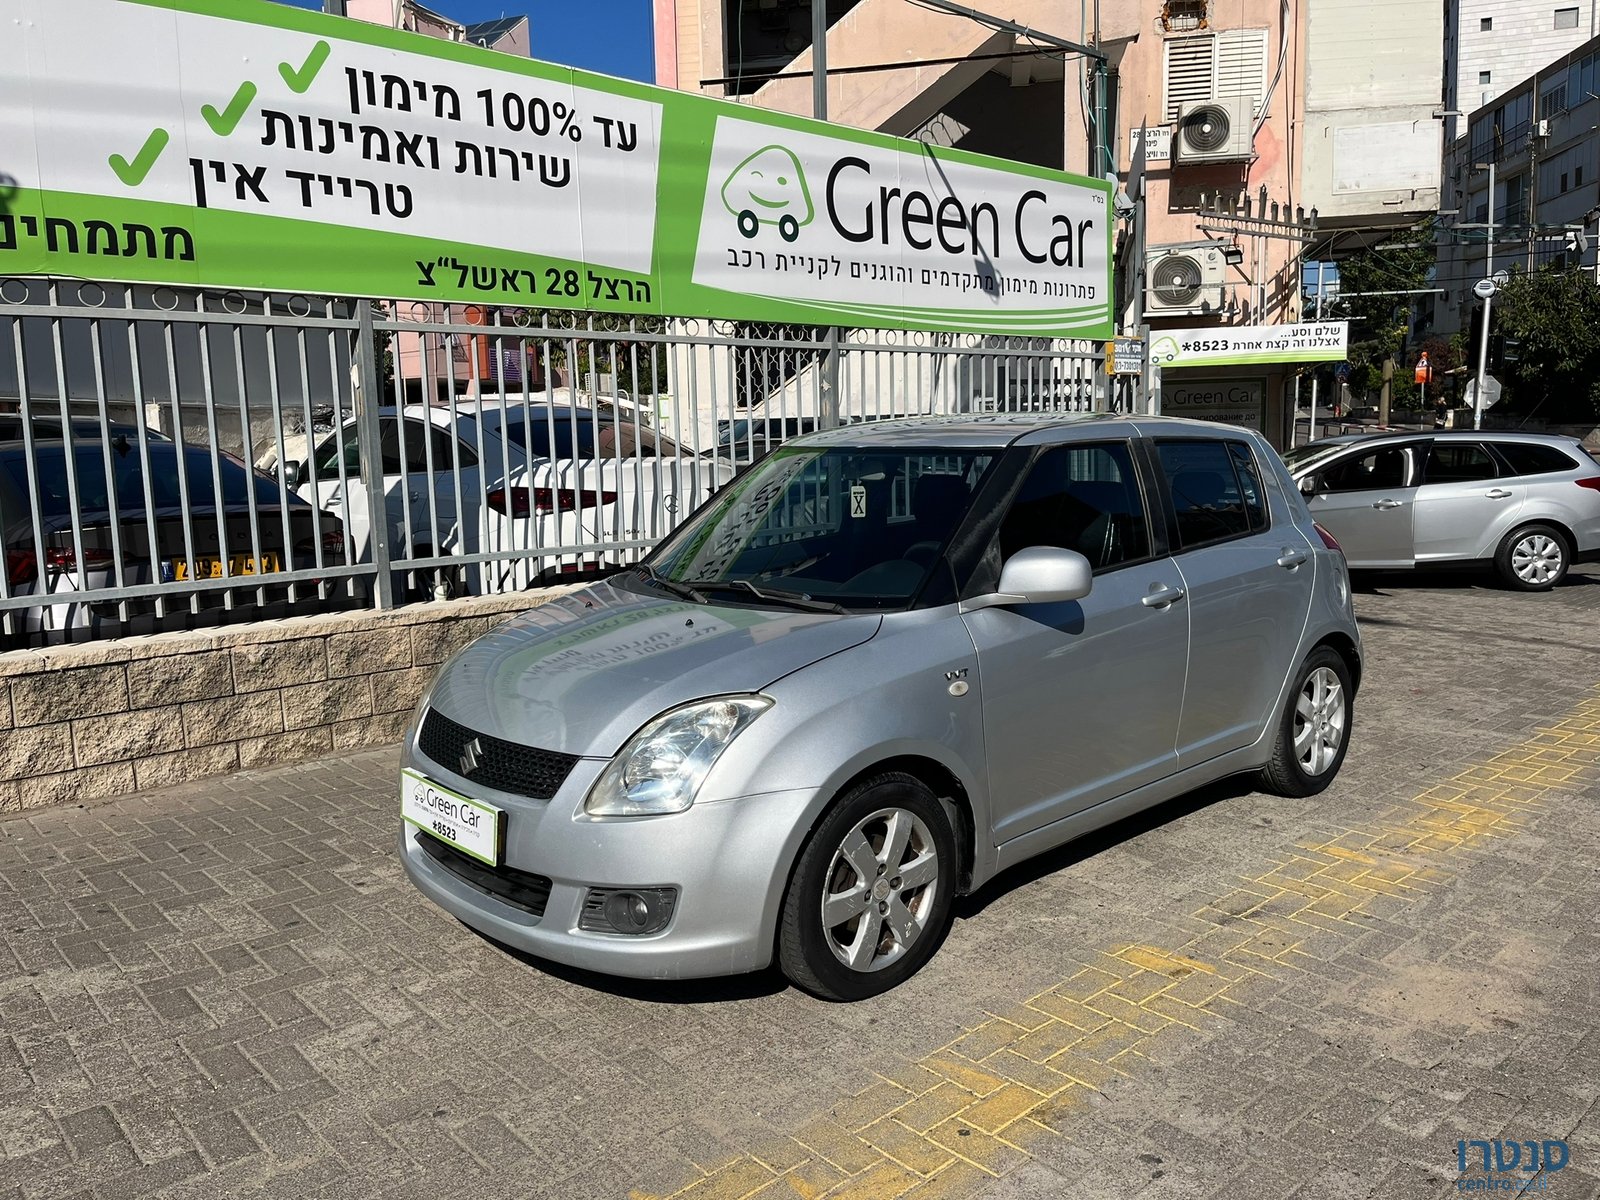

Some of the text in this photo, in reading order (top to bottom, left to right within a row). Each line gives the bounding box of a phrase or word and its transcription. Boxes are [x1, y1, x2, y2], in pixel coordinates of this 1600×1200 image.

[344, 66, 638, 152] עד 100% מימון
[1146, 130, 1161, 138] הרצ
[260, 109, 571, 188] שירות ואמינות
[189, 157, 414, 219] טרייד אין
[825, 156, 1093, 269] Green Car
[545, 267, 580, 297] 28
[727, 248, 1095, 300] פתרונות מימון מתקדמים והוגנים לקניית רכב
[587, 270, 652, 304] הרצל
[1315, 326, 1341, 337] שלם
[1232, 340, 1262, 350] אחרת
[1265, 339, 1289, 350] קצת
[1292, 338, 1306, 347] זה
[1308, 337, 1341, 348] אצלנו
[1174, 387, 1255, 405] Green Car
[1244, 412, 1256, 421] до
[944, 668, 969, 681] VVT
[427, 788, 458, 819] Green
[460, 804, 480, 828] Car
